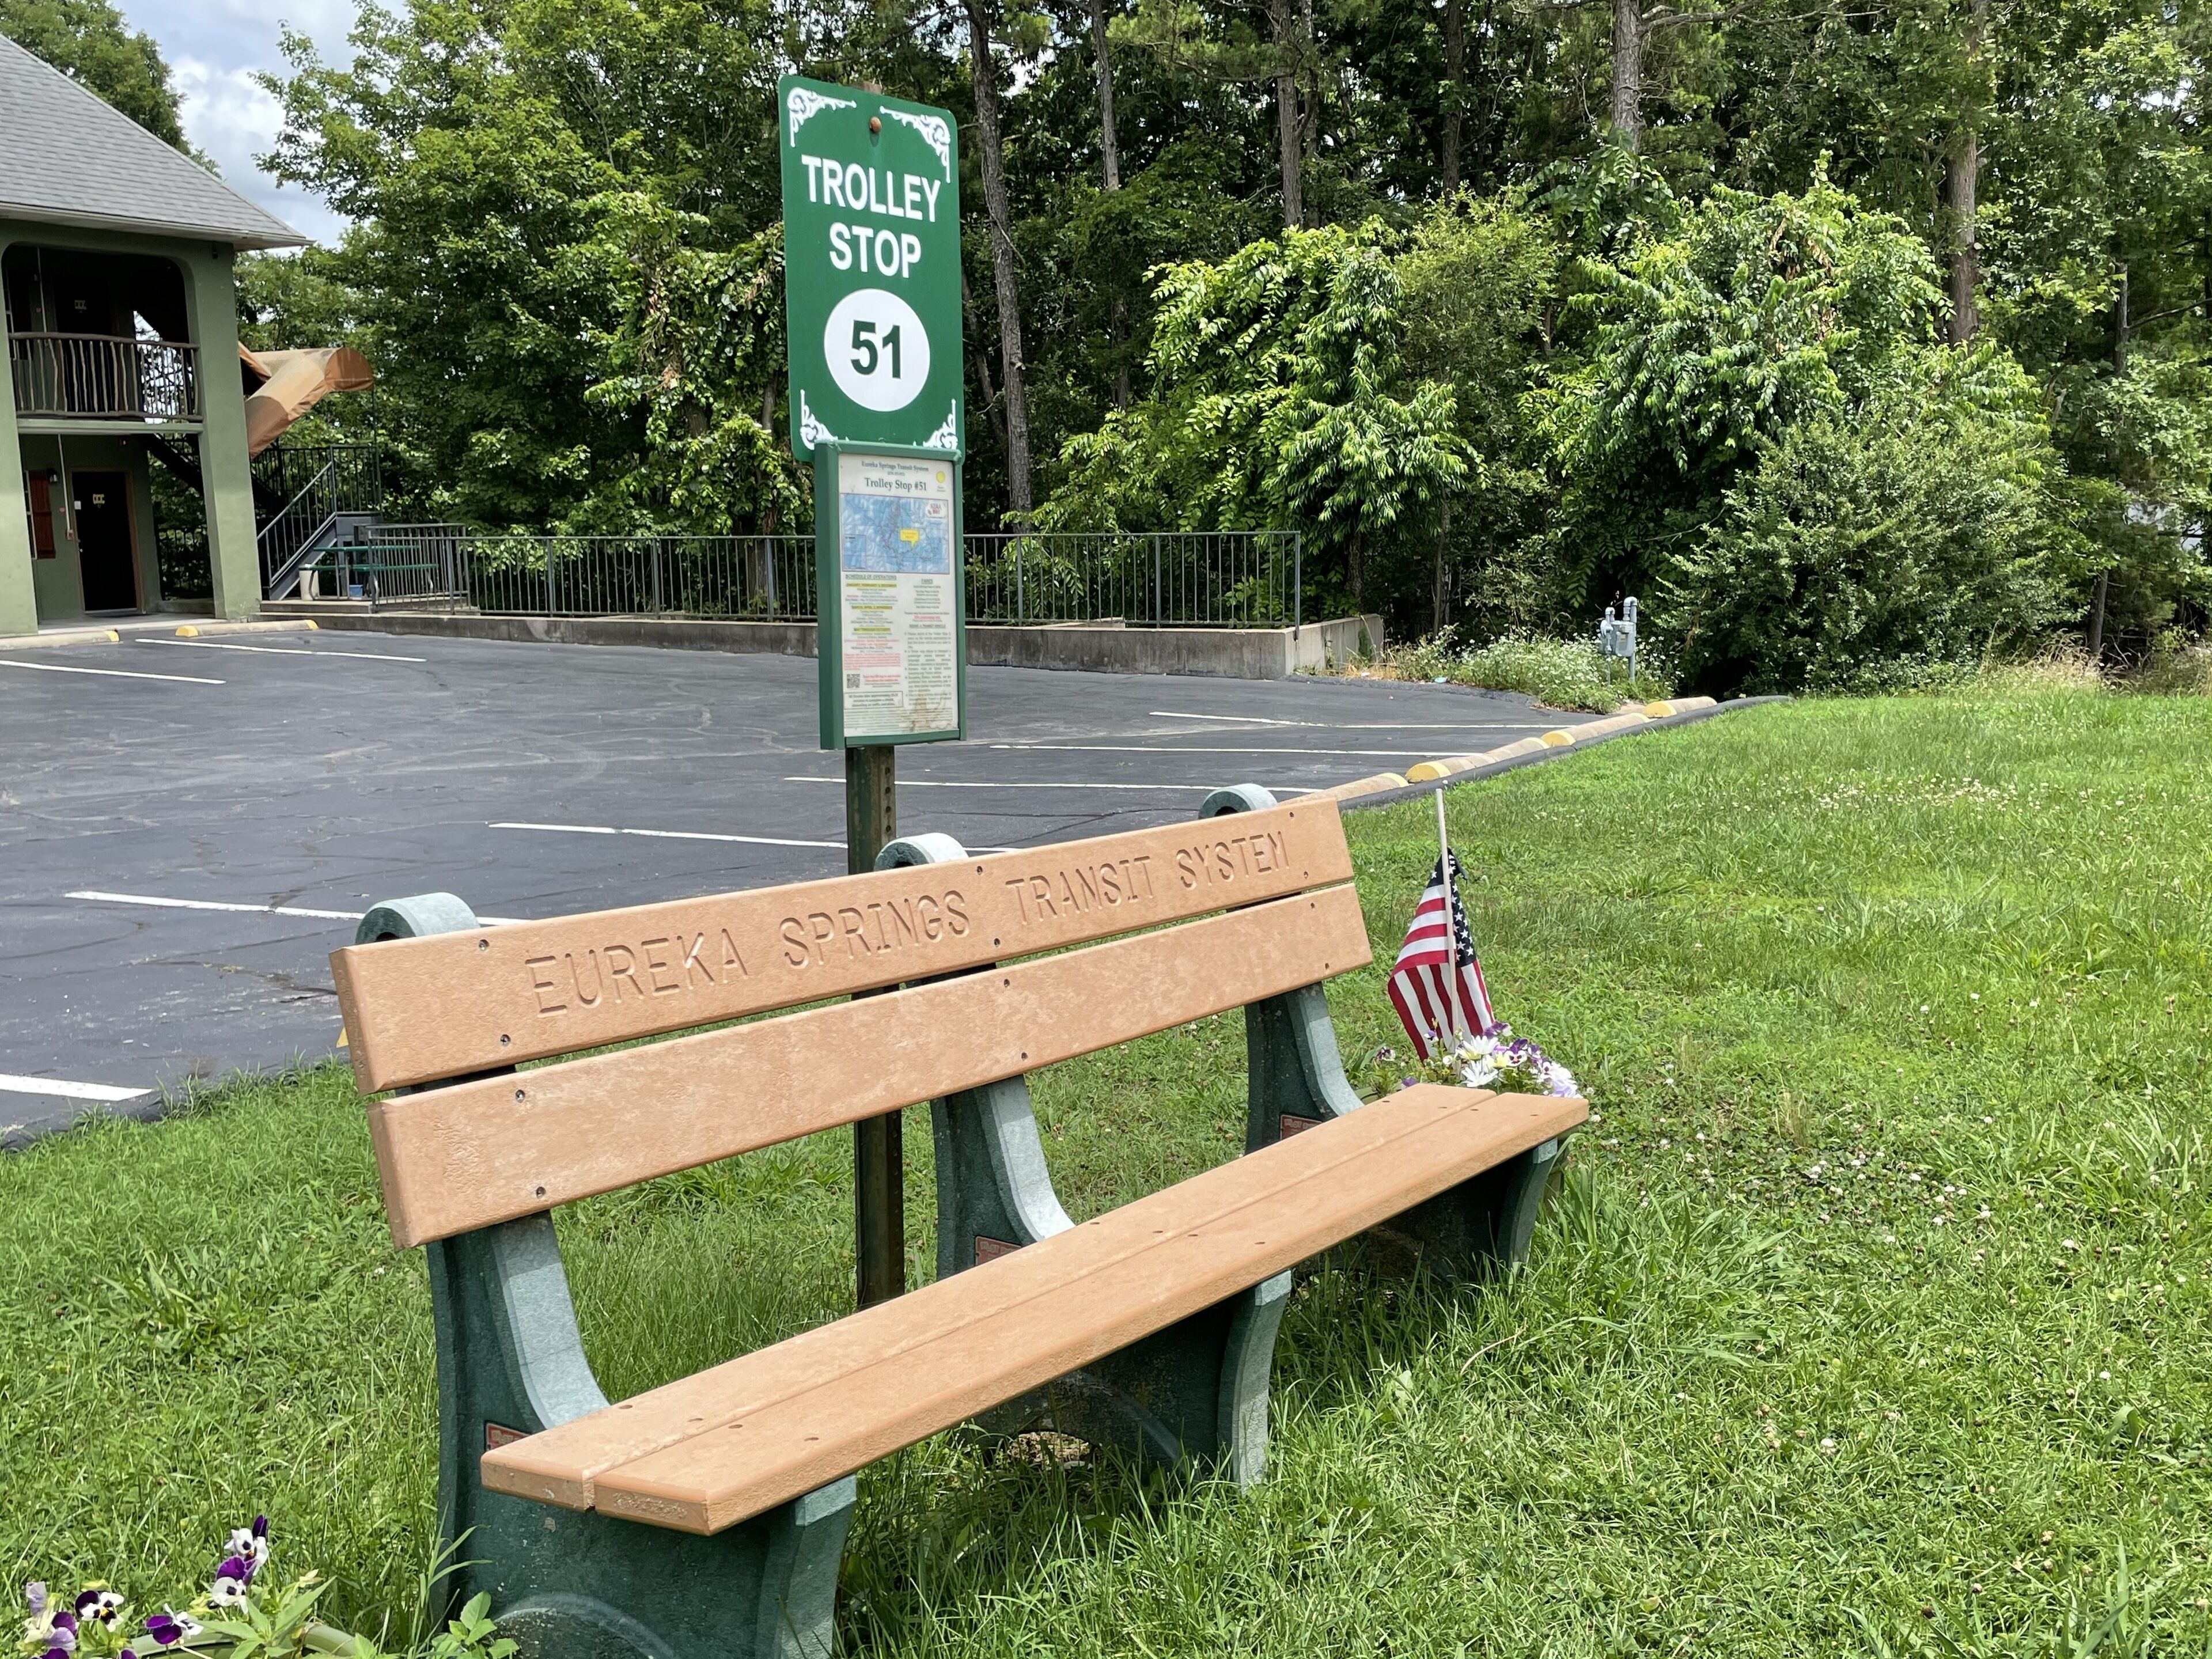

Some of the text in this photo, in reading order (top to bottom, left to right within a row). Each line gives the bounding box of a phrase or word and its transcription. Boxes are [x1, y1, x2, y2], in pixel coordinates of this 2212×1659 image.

[801, 154, 941, 223] TROLLEY
[829, 222, 922, 279] STOP
[850, 319, 902, 380] 51
[865, 478, 893, 491] Trolley
[895, 480, 912, 493] Stop
[914, 482, 927, 491] #51
[879, 462, 896, 470] Springs
[914, 465, 929, 474] System
[525, 831, 1290, 1018] EUREKA SPRINGS TRANSIT SYSTEM
